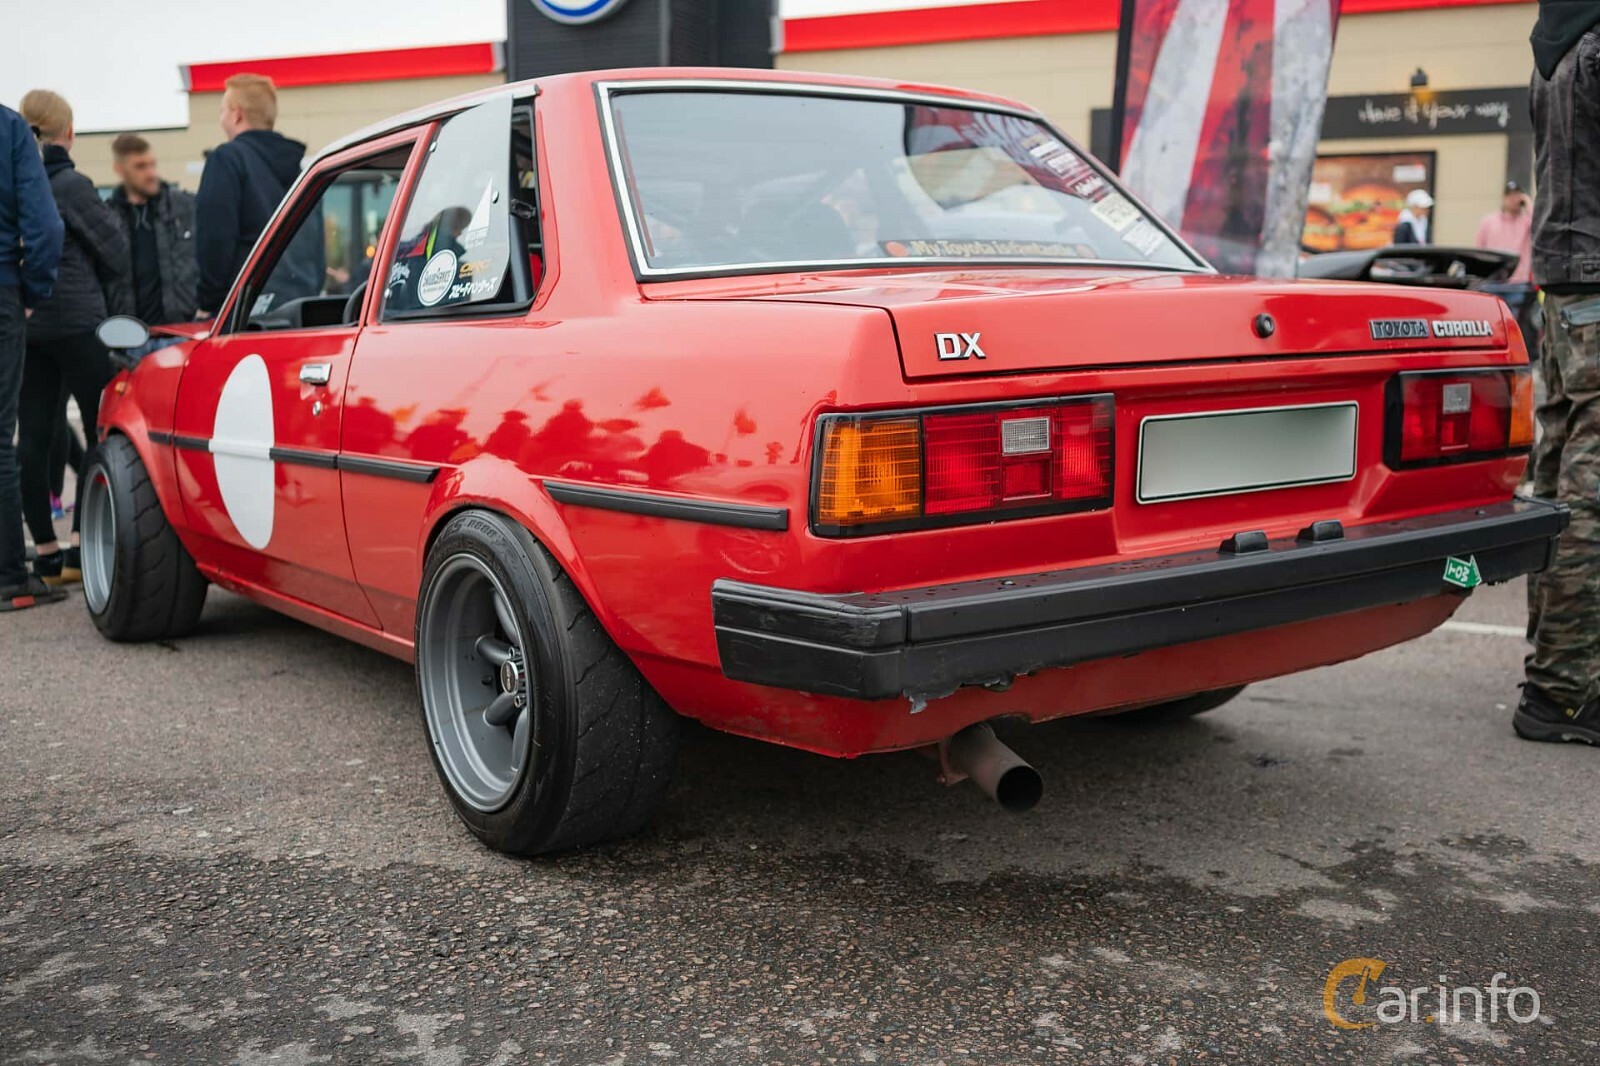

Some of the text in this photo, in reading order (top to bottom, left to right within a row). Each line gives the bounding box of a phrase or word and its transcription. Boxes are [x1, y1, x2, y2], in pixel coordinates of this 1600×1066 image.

[937, 240, 997, 257] Toyota
[1373, 319, 1493, 338] TOYOTA COROLLA
[934, 332, 986, 361] DX
[1448, 563, 1470, 582] TOW
